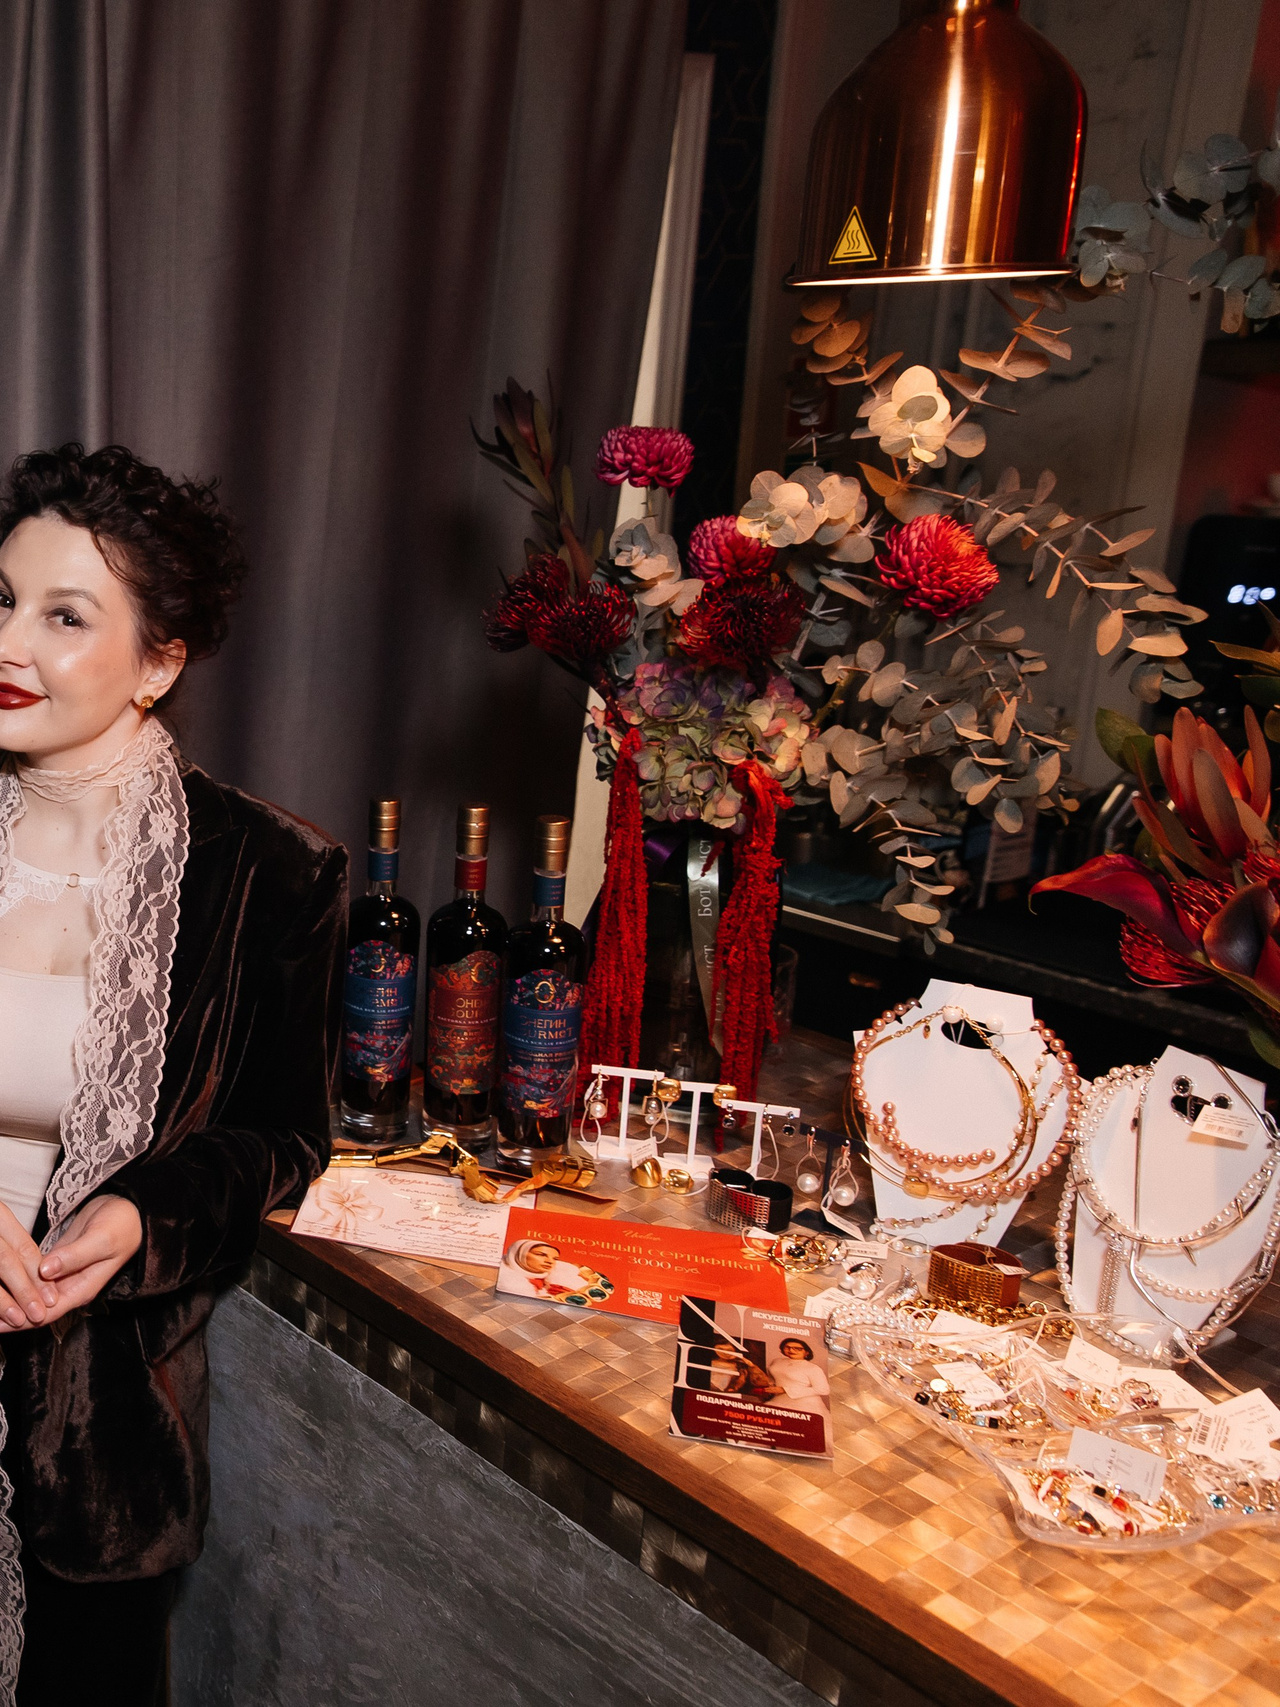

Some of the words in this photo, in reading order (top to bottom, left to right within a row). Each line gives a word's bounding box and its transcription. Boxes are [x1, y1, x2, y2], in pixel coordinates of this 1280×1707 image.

[628, 1255, 671, 1270] 3000
[752, 1311, 798, 1325] ИСКУССТВО
[798, 1318, 822, 1329] БЫТЬ
[762, 1322, 811, 1337] ЖЕНЩИНОЙ
[696, 1394, 754, 1412] ПОДАРОЧНЫЙ
[755, 1405, 812, 1422] СЕРТИФИКАТ
[724, 1410, 746, 1421] 7500
[746, 1414, 782, 1427] РУБЛЕЙ
